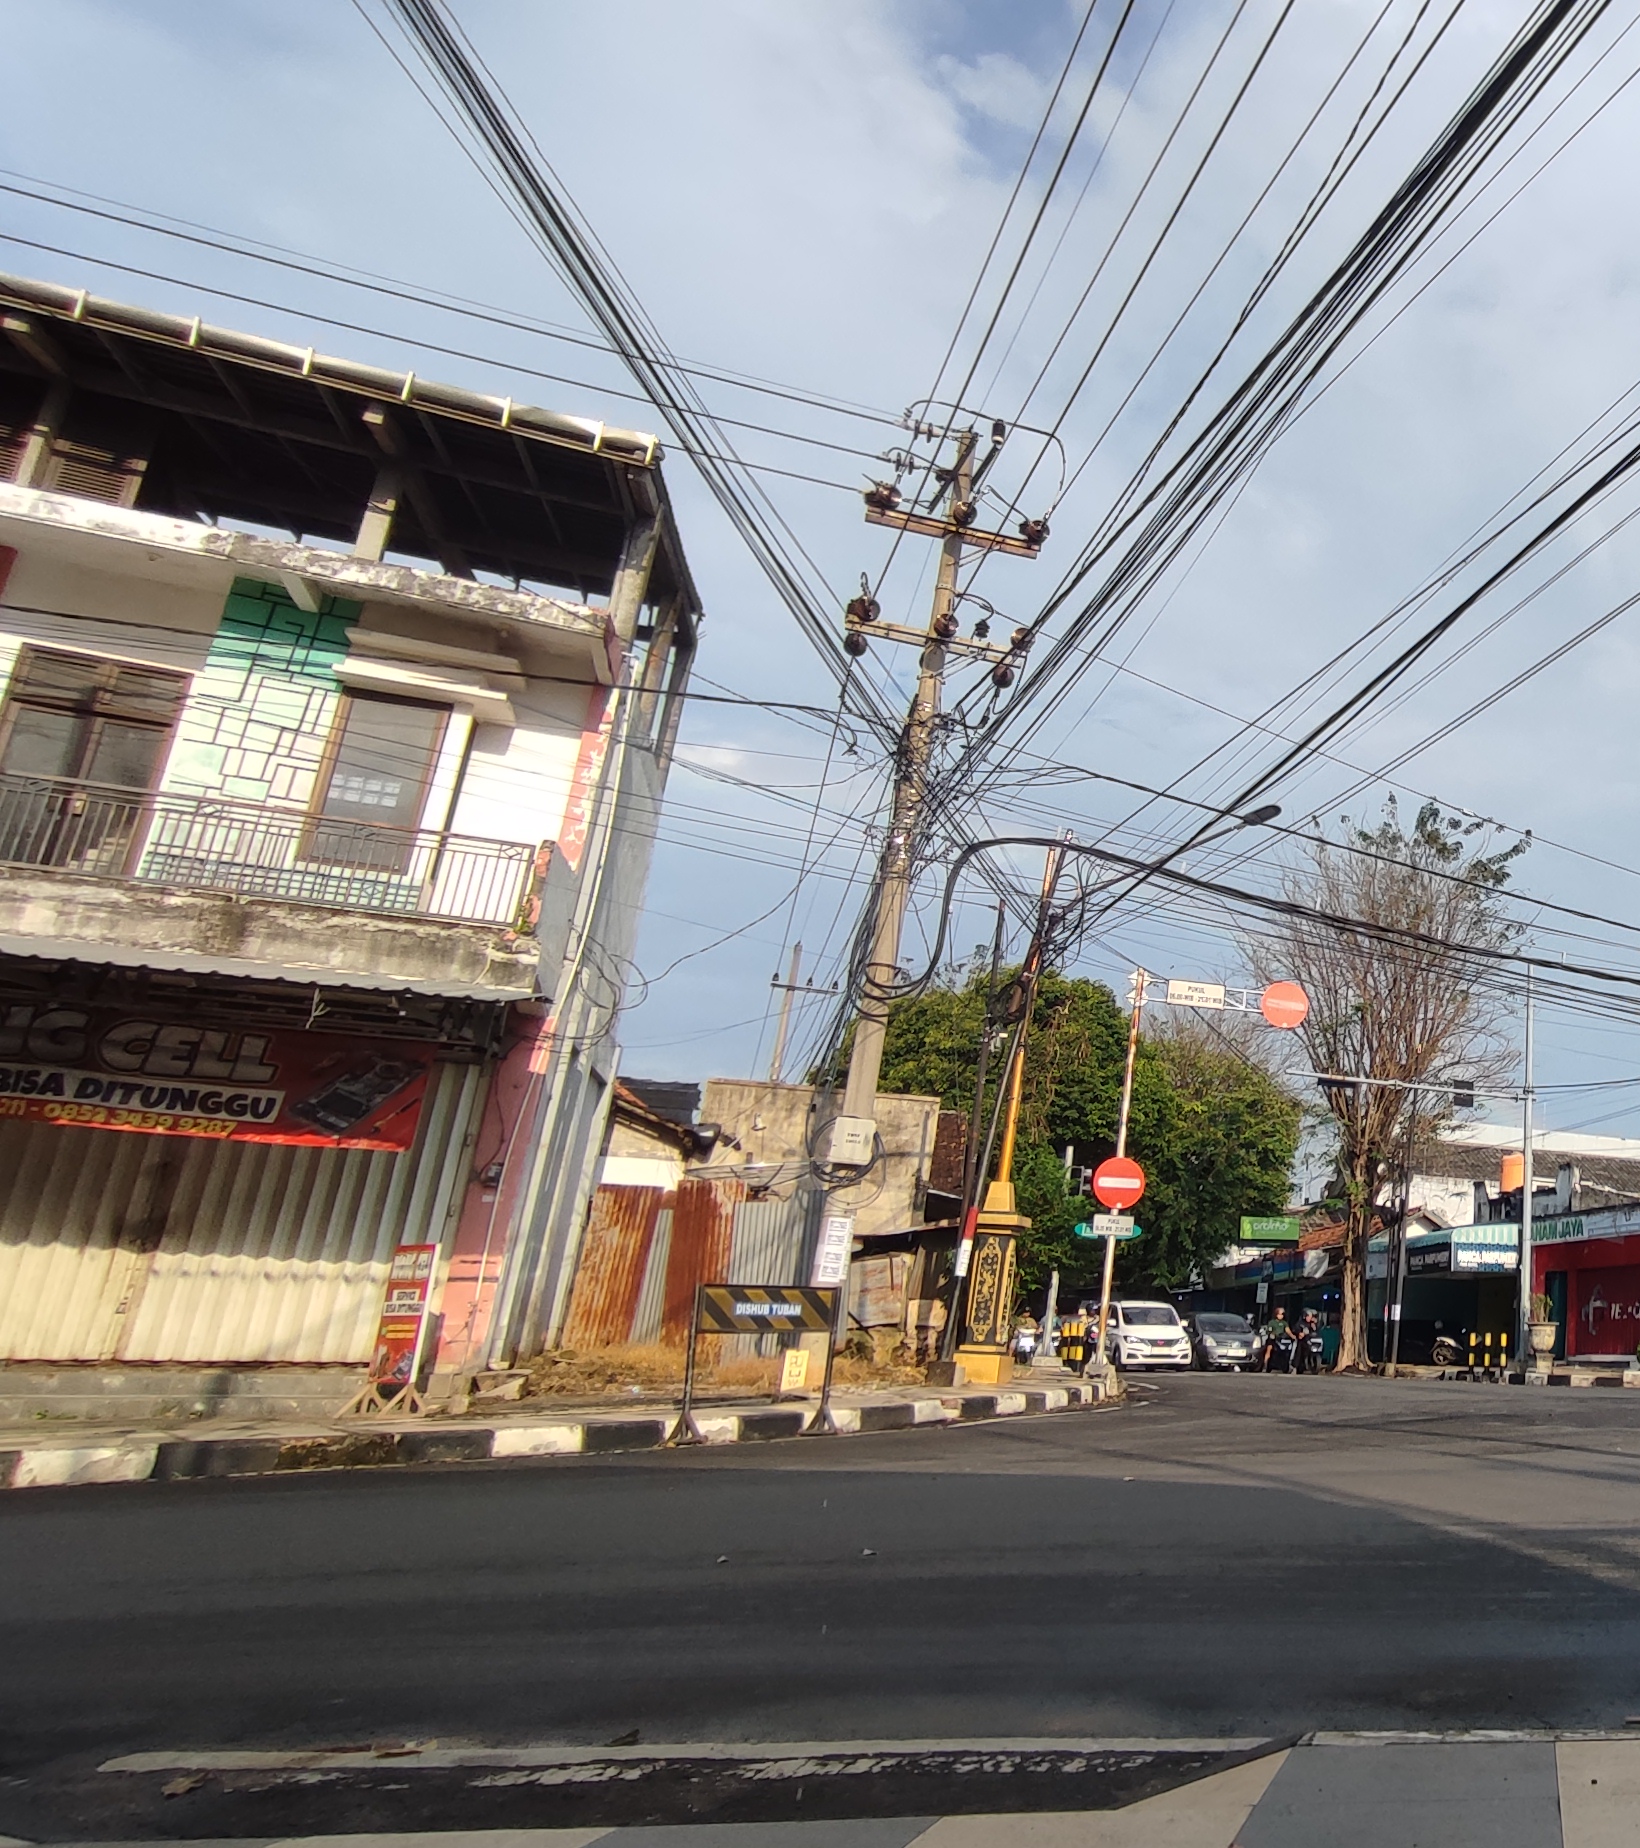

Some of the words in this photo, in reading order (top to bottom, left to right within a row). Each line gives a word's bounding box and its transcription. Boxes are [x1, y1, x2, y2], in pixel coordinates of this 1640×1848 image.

[99, 1020, 280, 1083] CELL
[74, 1078, 277, 1119] DITUNGGU
[44, 1103, 106, 1123] 0852
[1558, 1217, 1584, 1239] JAYA
[735, 1303, 770, 1316] DISHUB
[771, 1304, 802, 1316] TUBAN
